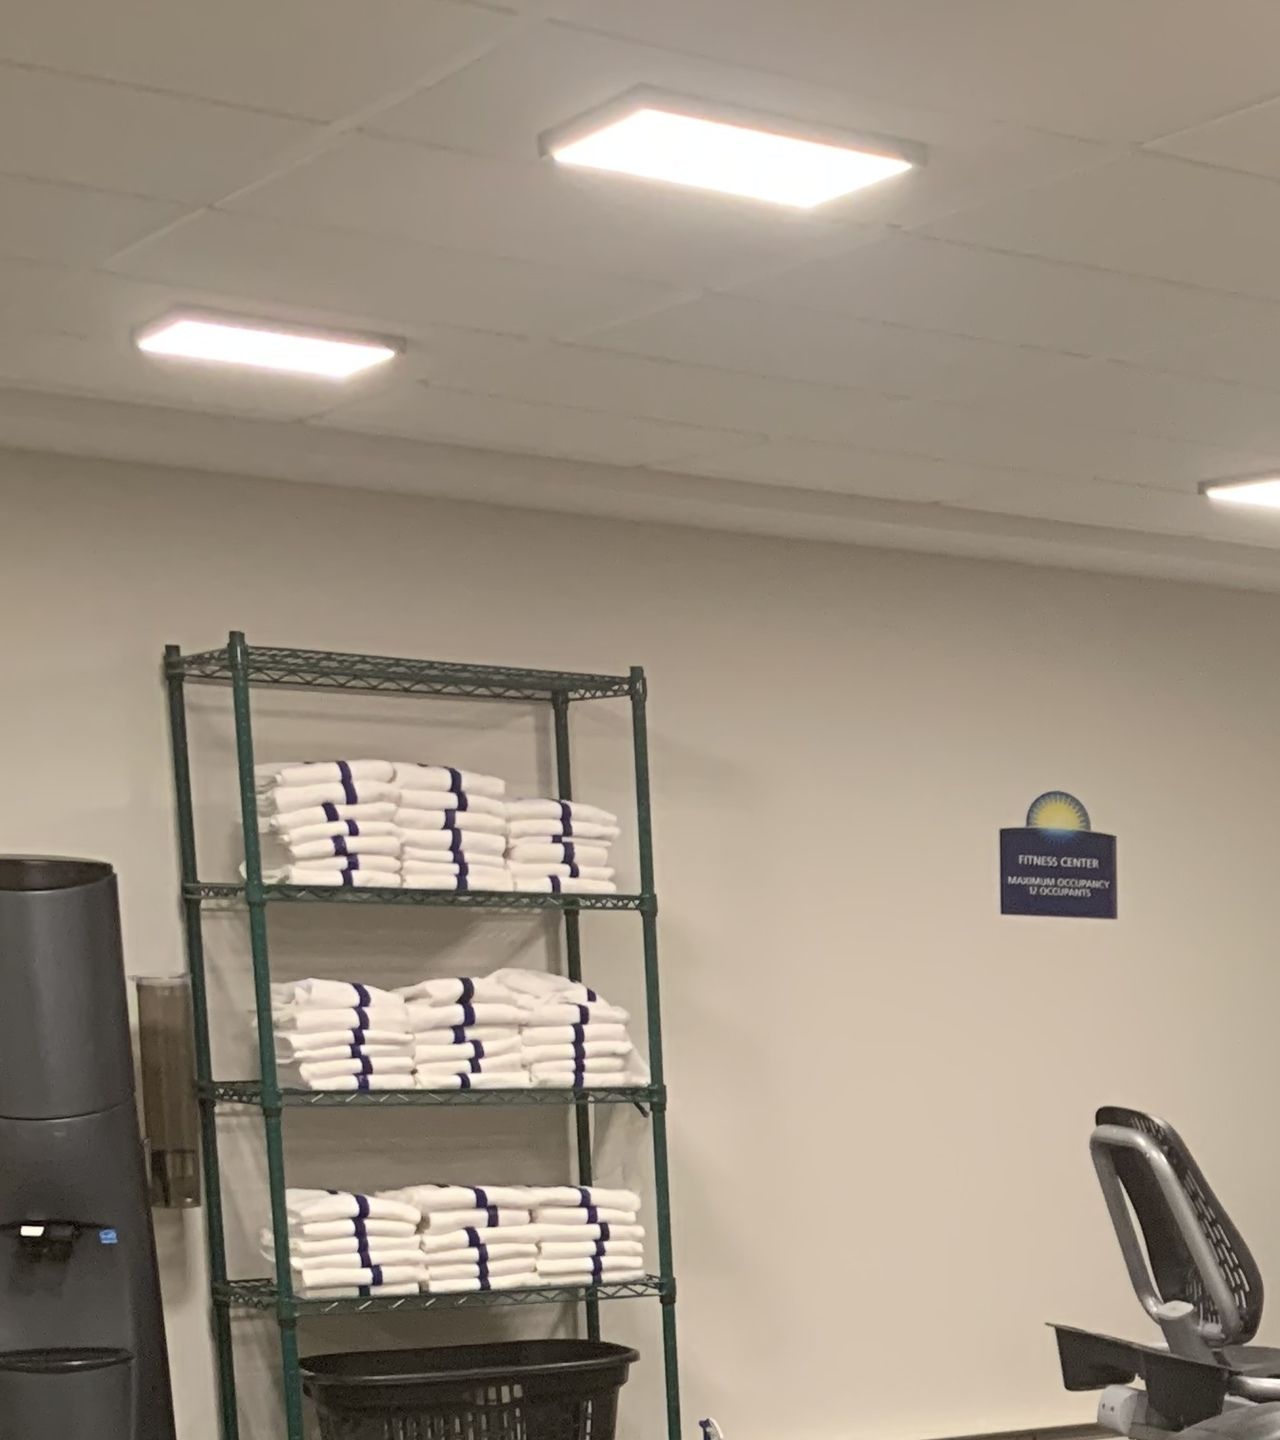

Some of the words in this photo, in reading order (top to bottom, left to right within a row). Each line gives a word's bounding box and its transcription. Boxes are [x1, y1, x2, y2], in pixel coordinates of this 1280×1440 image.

[1018, 854, 1058, 867] FITNESS
[1060, 856, 1099, 869] CENTER
[1007, 876, 1055, 886] MAXIMUM
[1057, 877, 1110, 889] OCCUPANCY
[1039, 887, 1091, 898] OCCUPANTS
